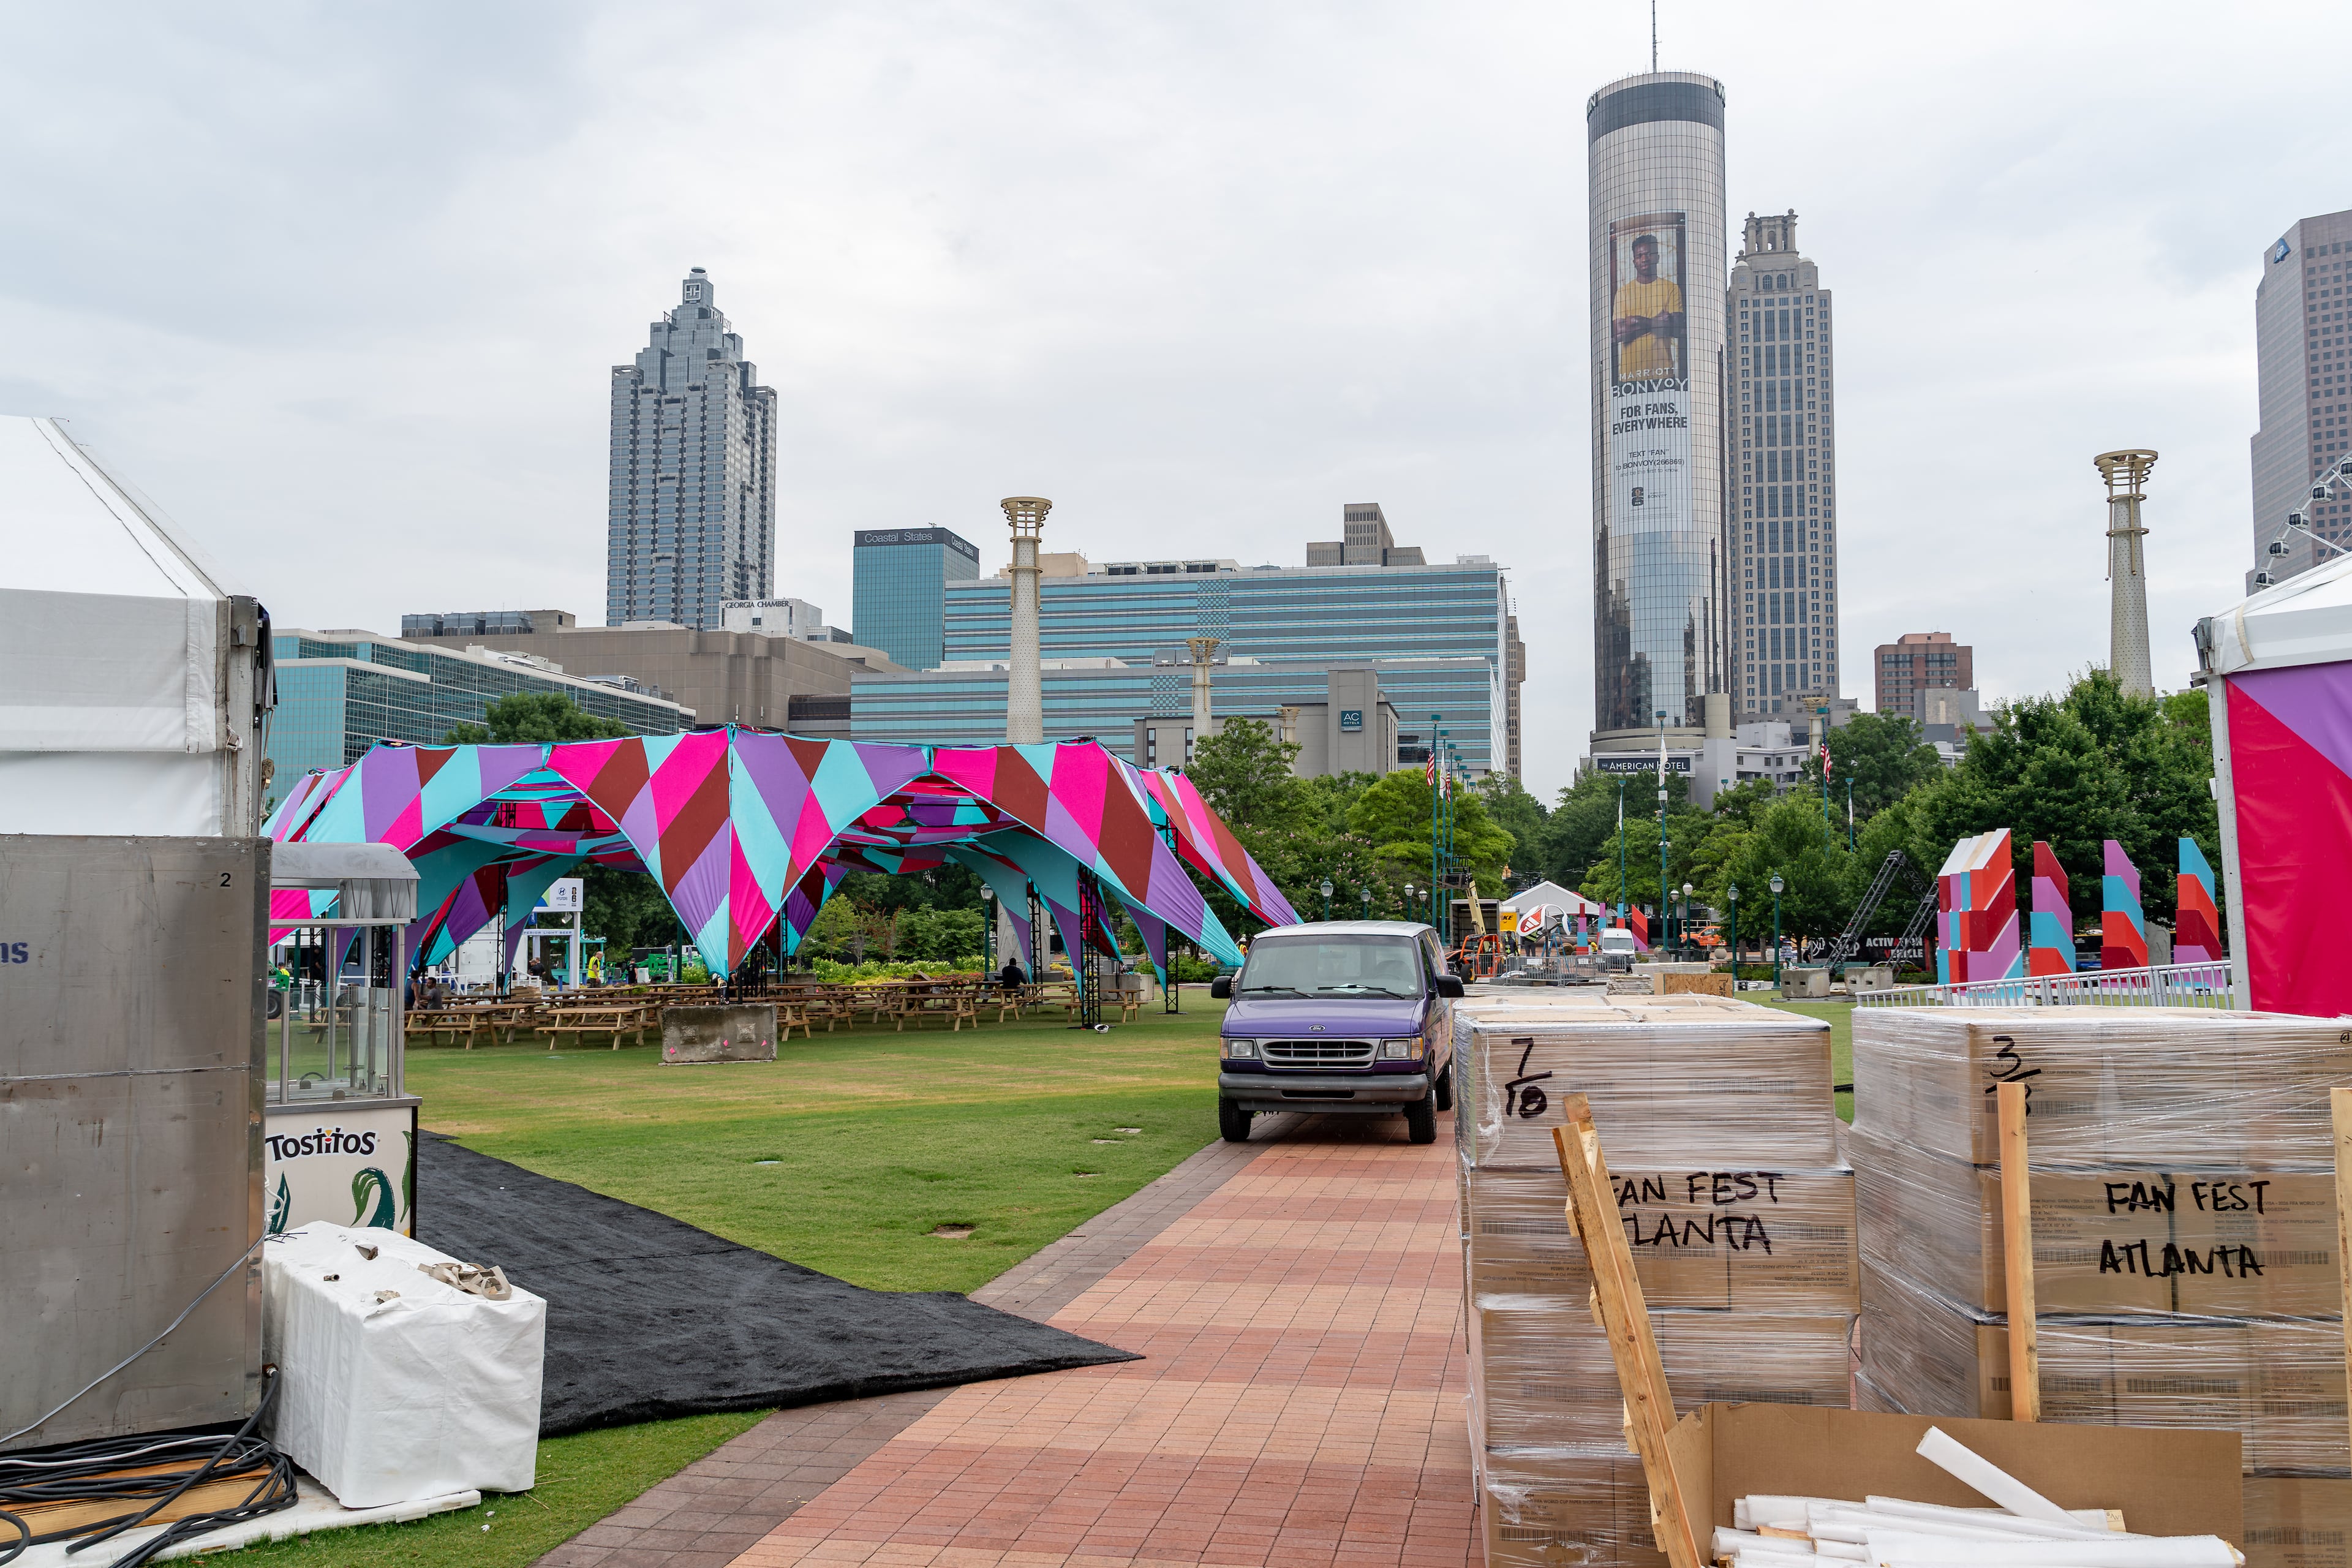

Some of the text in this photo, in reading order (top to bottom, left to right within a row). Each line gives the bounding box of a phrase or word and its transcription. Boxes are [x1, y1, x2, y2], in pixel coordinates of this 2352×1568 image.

[2276, 244, 2284, 258] GP
[1619, 368, 1677, 380] MARRIOTT
[1611, 378, 1688, 398] BONVOY
[1621, 402, 1678, 419] FOR FANS,
[1613, 417, 1687, 435] EVERYWHERE
[865, 532, 932, 543] Coastal States
[951, 535, 974, 557] Coastal States
[1609, 761, 1654, 770] AMERICAN
[1657, 761, 1686, 770] HOTEL
[221, 873, 230, 887] 2
[1866, 937, 1922, 947] ACTIVATION
[1884, 949, 1923, 959] VEHICLE
[1686, 1171, 1787, 1205] FEST
[2104, 1180, 2271, 1215] FAN FEST
[1623, 1213, 1772, 1255] LANTA
[2100, 1239, 2267, 1278] ATLANTA
